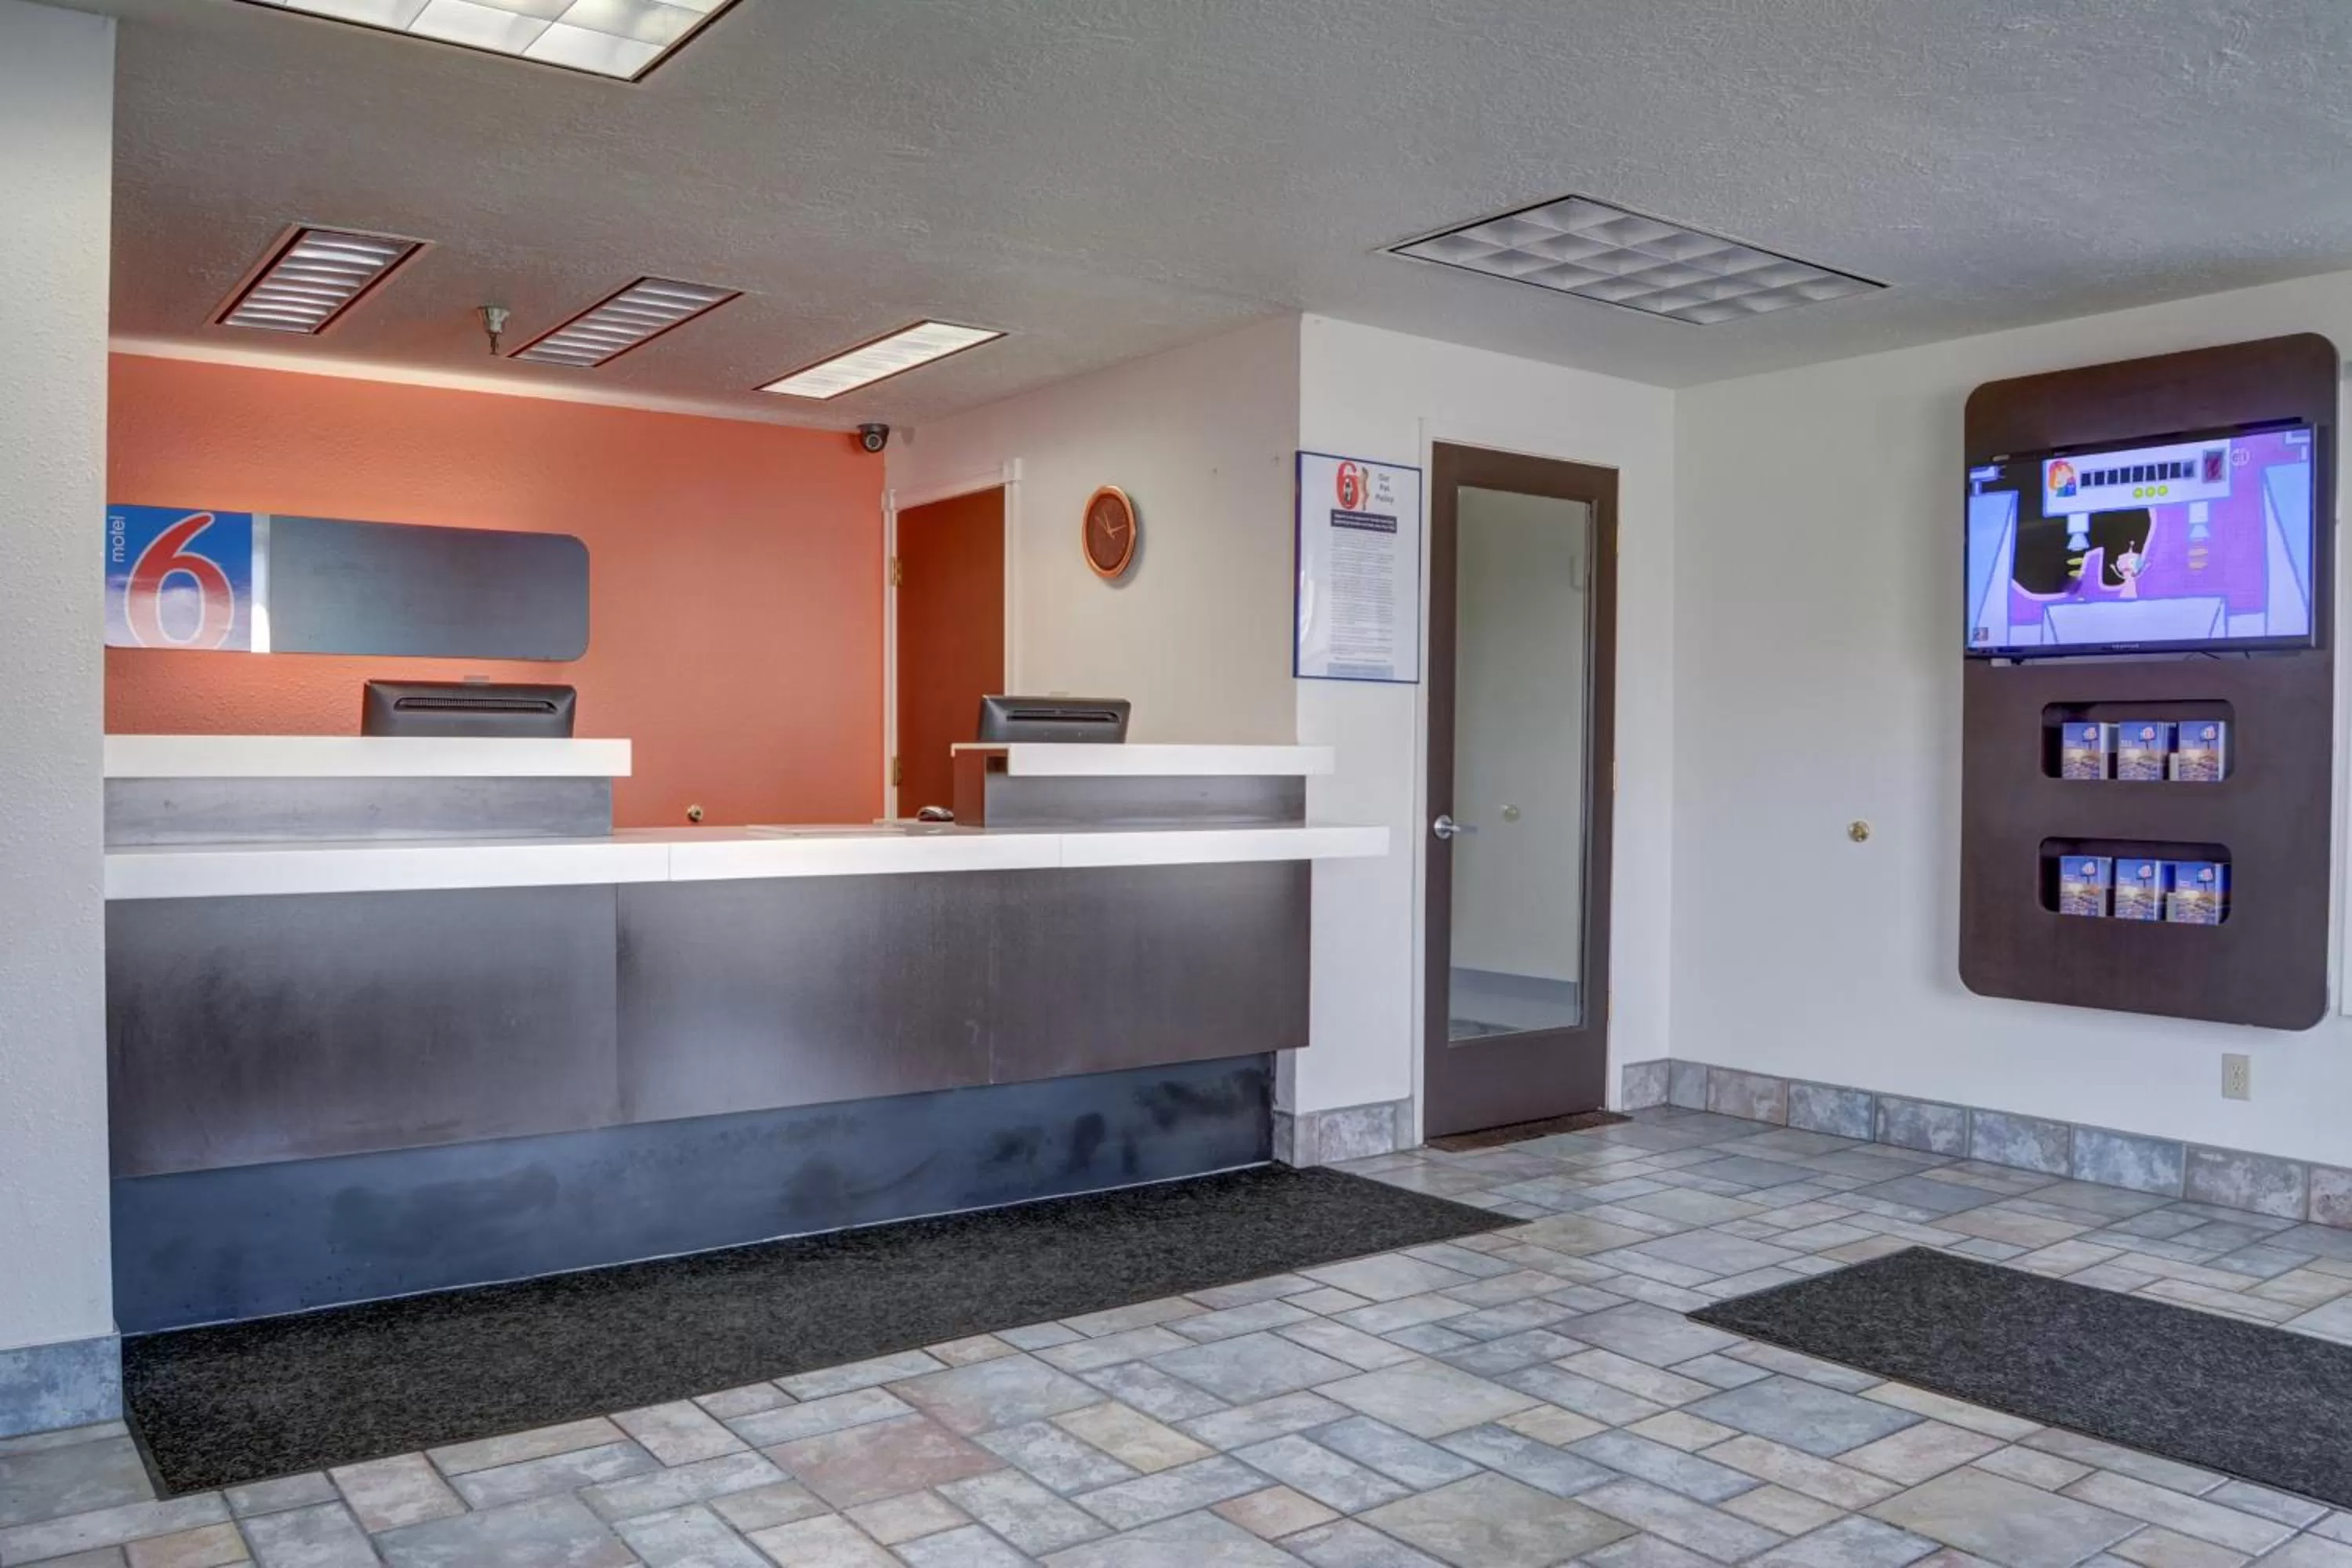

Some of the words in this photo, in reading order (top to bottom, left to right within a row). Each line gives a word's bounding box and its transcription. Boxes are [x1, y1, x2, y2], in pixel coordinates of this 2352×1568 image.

[1338, 461, 1359, 510] 6
[109, 515, 125, 562] motel
[125, 512, 234, 649] 6
